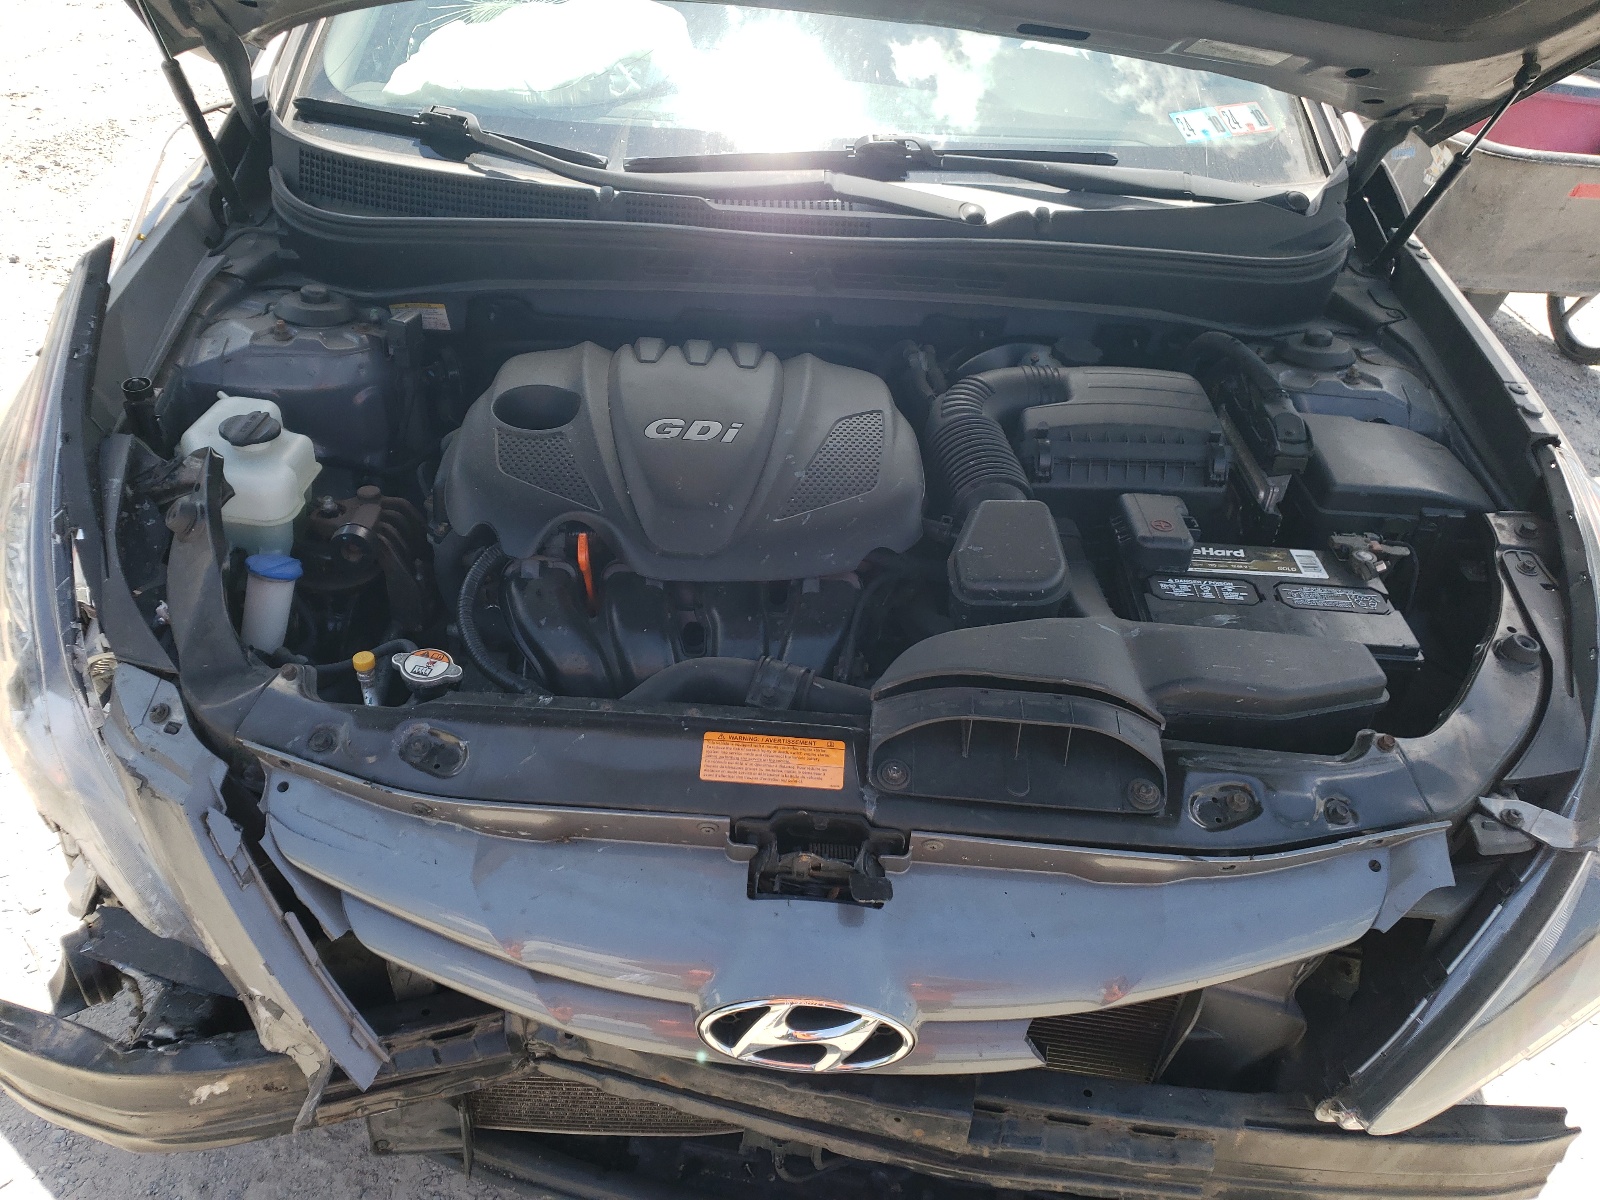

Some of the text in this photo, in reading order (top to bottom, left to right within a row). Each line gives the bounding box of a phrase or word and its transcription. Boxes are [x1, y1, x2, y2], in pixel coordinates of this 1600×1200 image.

[1175, 116, 1197, 137] 24
[1221, 109, 1243, 130] 24
[643, 417, 745, 444] GDi
[1192, 547, 1246, 558] eHard
[764, 737, 817, 746] AVERTISSEMENT
